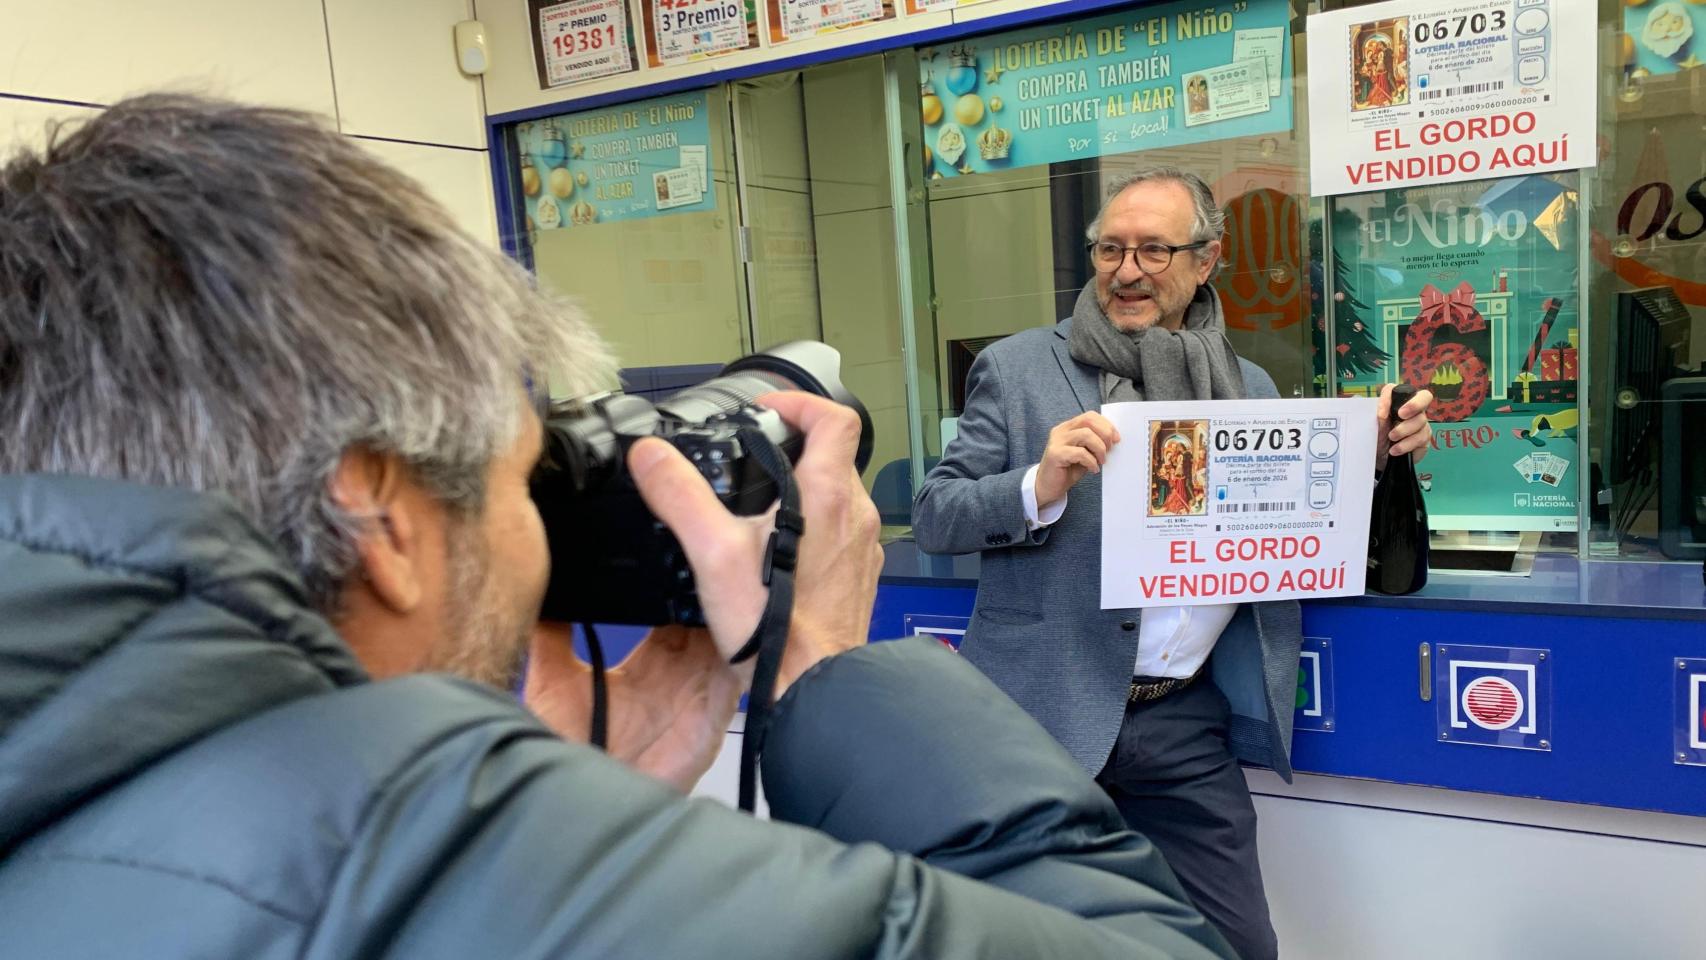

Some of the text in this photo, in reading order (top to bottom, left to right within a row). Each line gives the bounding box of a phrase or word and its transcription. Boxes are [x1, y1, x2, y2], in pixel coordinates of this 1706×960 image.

[571, 14, 607, 29] PREMIO
[677, 1, 737, 28] Premio
[1414, 10, 1506, 44] 06703
[553, 24, 615, 58] 19381
[994, 27, 1088, 74] LOTERÍA
[1097, 25, 1126, 56] DE
[1414, 34, 1508, 54] LOTERÍA NACIONAL
[564, 60, 593, 72] VENDIDO
[1476, 56, 1493, 64] 2026
[1018, 50, 1171, 101] COMPRA TAMBIÉN
[623, 111, 640, 129] DE
[1019, 86, 1176, 130] UN TICKET AL AZAR
[592, 128, 678, 160] COMPRA TAMBIÉN
[1104, 130, 1118, 144] si
[1375, 112, 1536, 152] EL GORDO
[607, 160, 640, 178] TICKET
[1346, 134, 1569, 185] VENDIDO AQUÍ
[1412, 254, 1434, 263] mejor
[1436, 252, 1454, 260] llega
[1456, 249, 1486, 258] cuando
[1450, 259, 1480, 268] esperas
[1214, 428, 1302, 452] 06703
[1214, 454, 1303, 463] LOTERÍA NACIONAL
[1170, 536, 1320, 564] EL GORDO
[1139, 562, 1346, 599] VENDIDO AQUÍ
